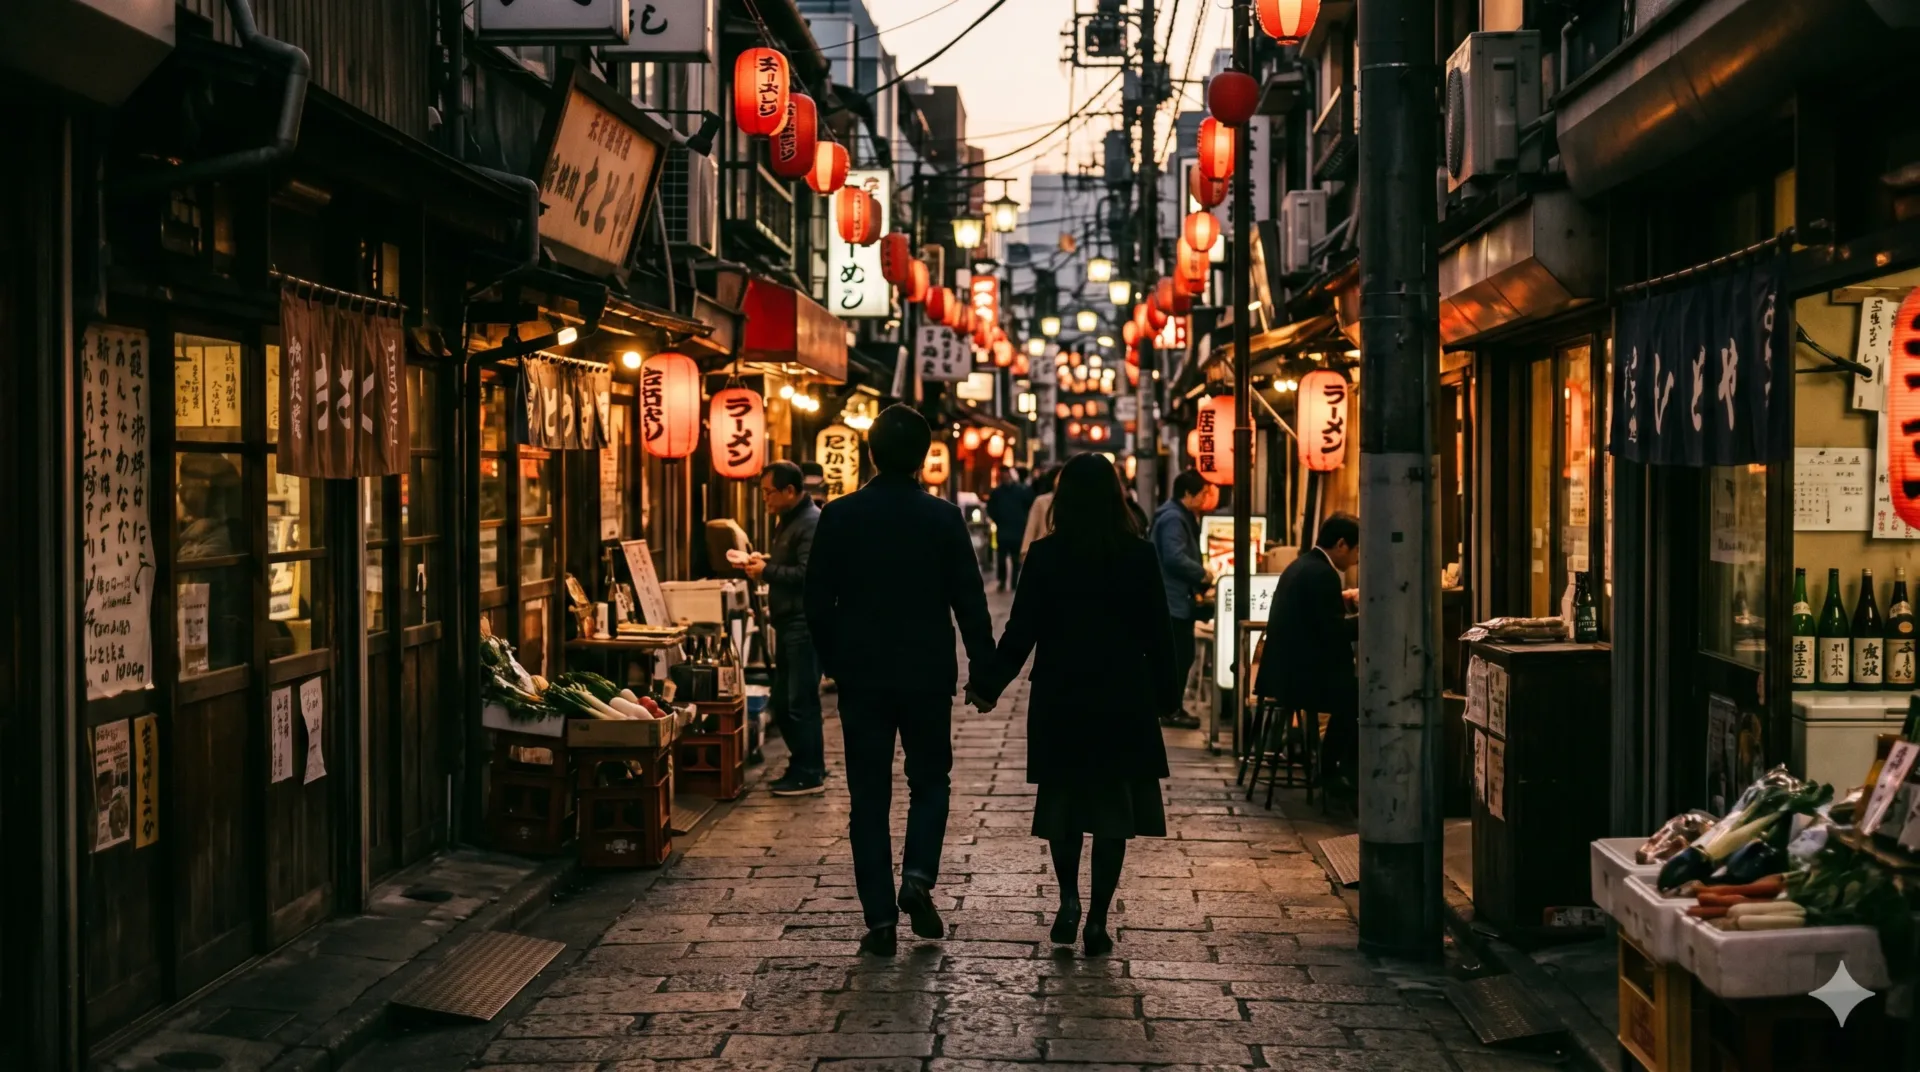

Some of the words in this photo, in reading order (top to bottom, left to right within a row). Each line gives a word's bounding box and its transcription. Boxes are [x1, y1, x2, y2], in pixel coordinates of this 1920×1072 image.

[725, 397, 753, 467] ラーメン
[1199, 409, 1217, 472] 居酒屋
[1321, 385, 1344, 453] ラーメン
